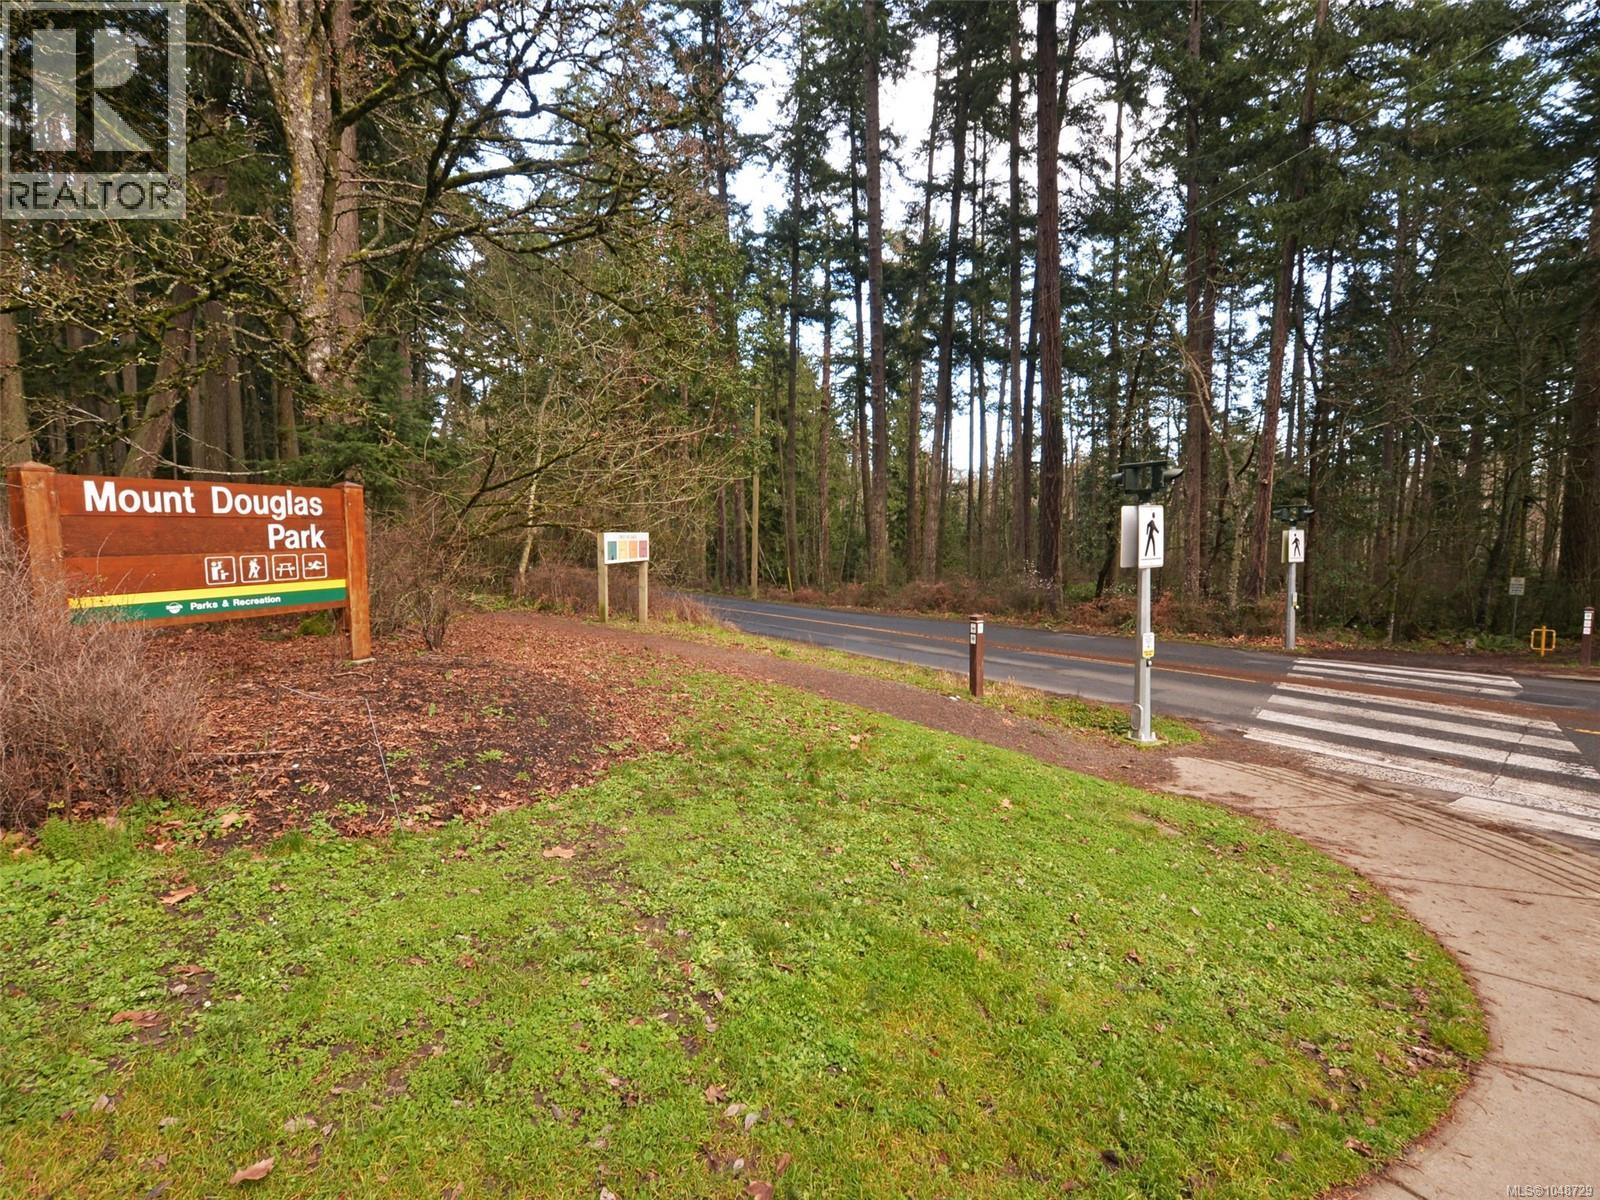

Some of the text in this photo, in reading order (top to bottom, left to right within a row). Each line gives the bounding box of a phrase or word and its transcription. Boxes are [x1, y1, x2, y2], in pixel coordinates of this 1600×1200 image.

[83, 480, 323, 521] Mount Douglas
[267, 523, 327, 550] Park
[189, 600, 219, 611] Parks
[221, 599, 230, 608] &
[232, 595, 282, 607] Recreation
